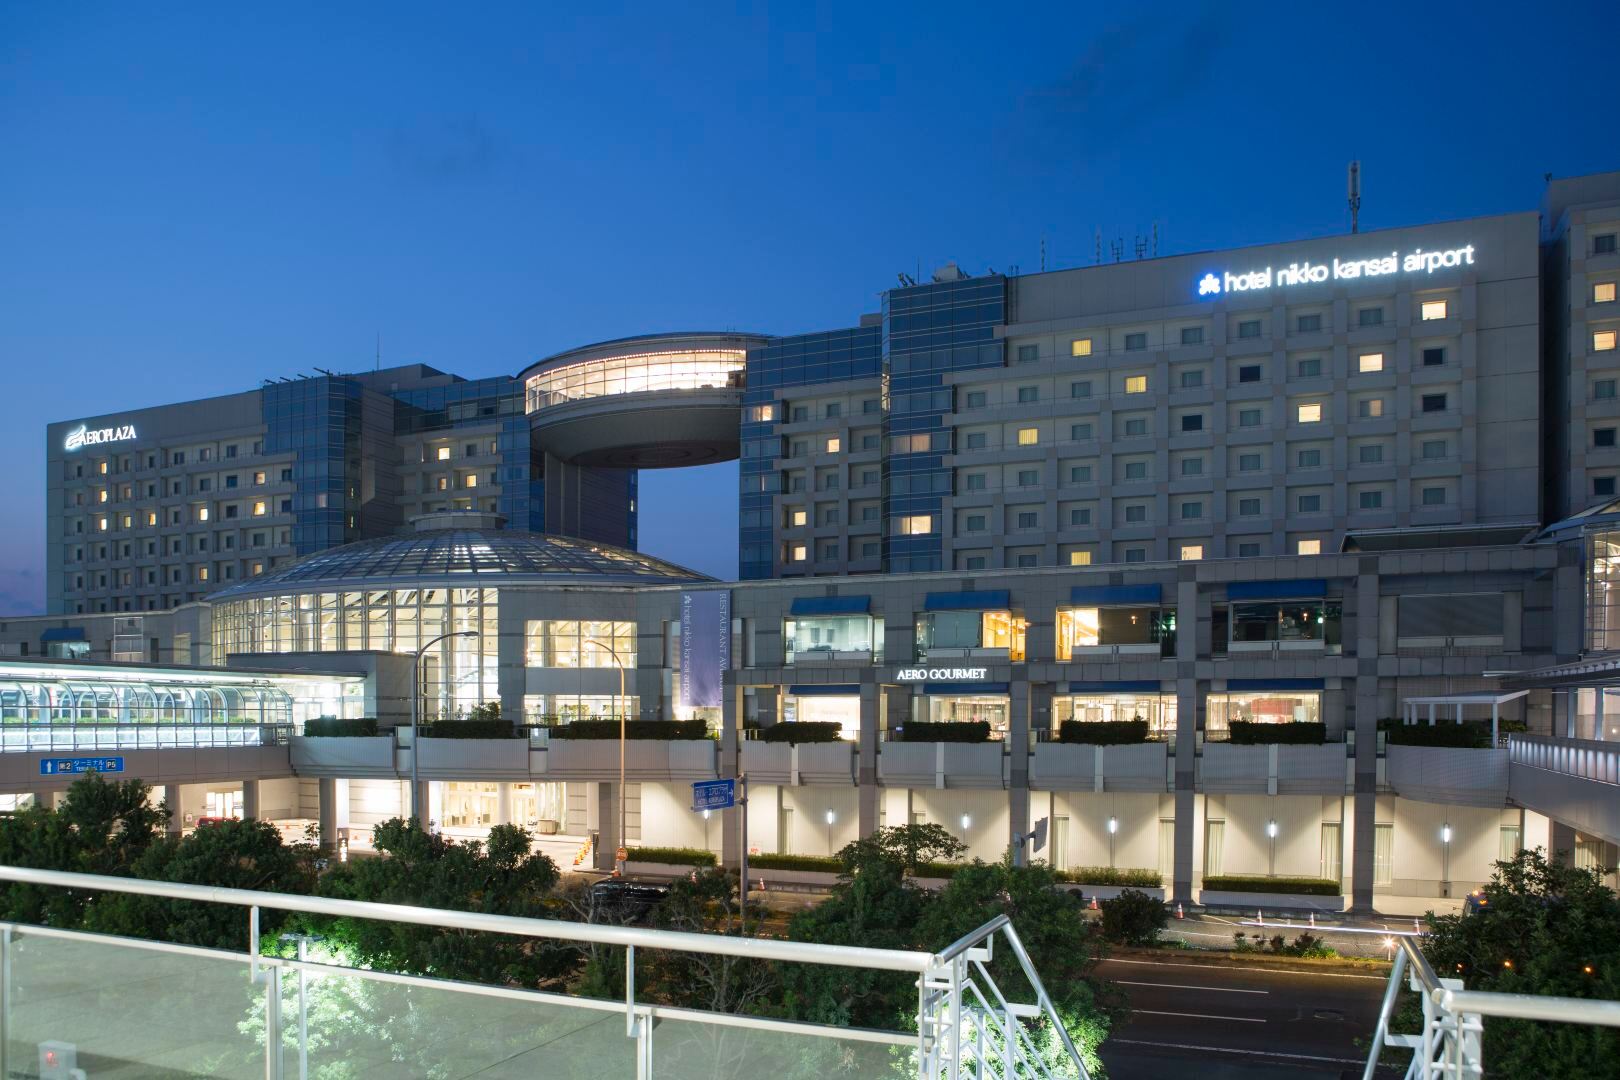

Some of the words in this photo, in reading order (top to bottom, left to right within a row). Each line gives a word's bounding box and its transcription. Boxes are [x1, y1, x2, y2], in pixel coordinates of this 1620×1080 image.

[1224, 267, 1271, 292] hotel
[1277, 262, 1328, 286] nikko
[1334, 252, 1397, 279] kansai
[1404, 245, 1474, 273] airport
[79, 425, 136, 445] AEROPLAZA
[683, 605, 692, 625] hotel
[719, 593, 727, 654] RESTAURANT
[683, 626, 692, 647] nikko
[897, 669, 927, 680] AERO
[929, 668, 987, 680] GOURMET
